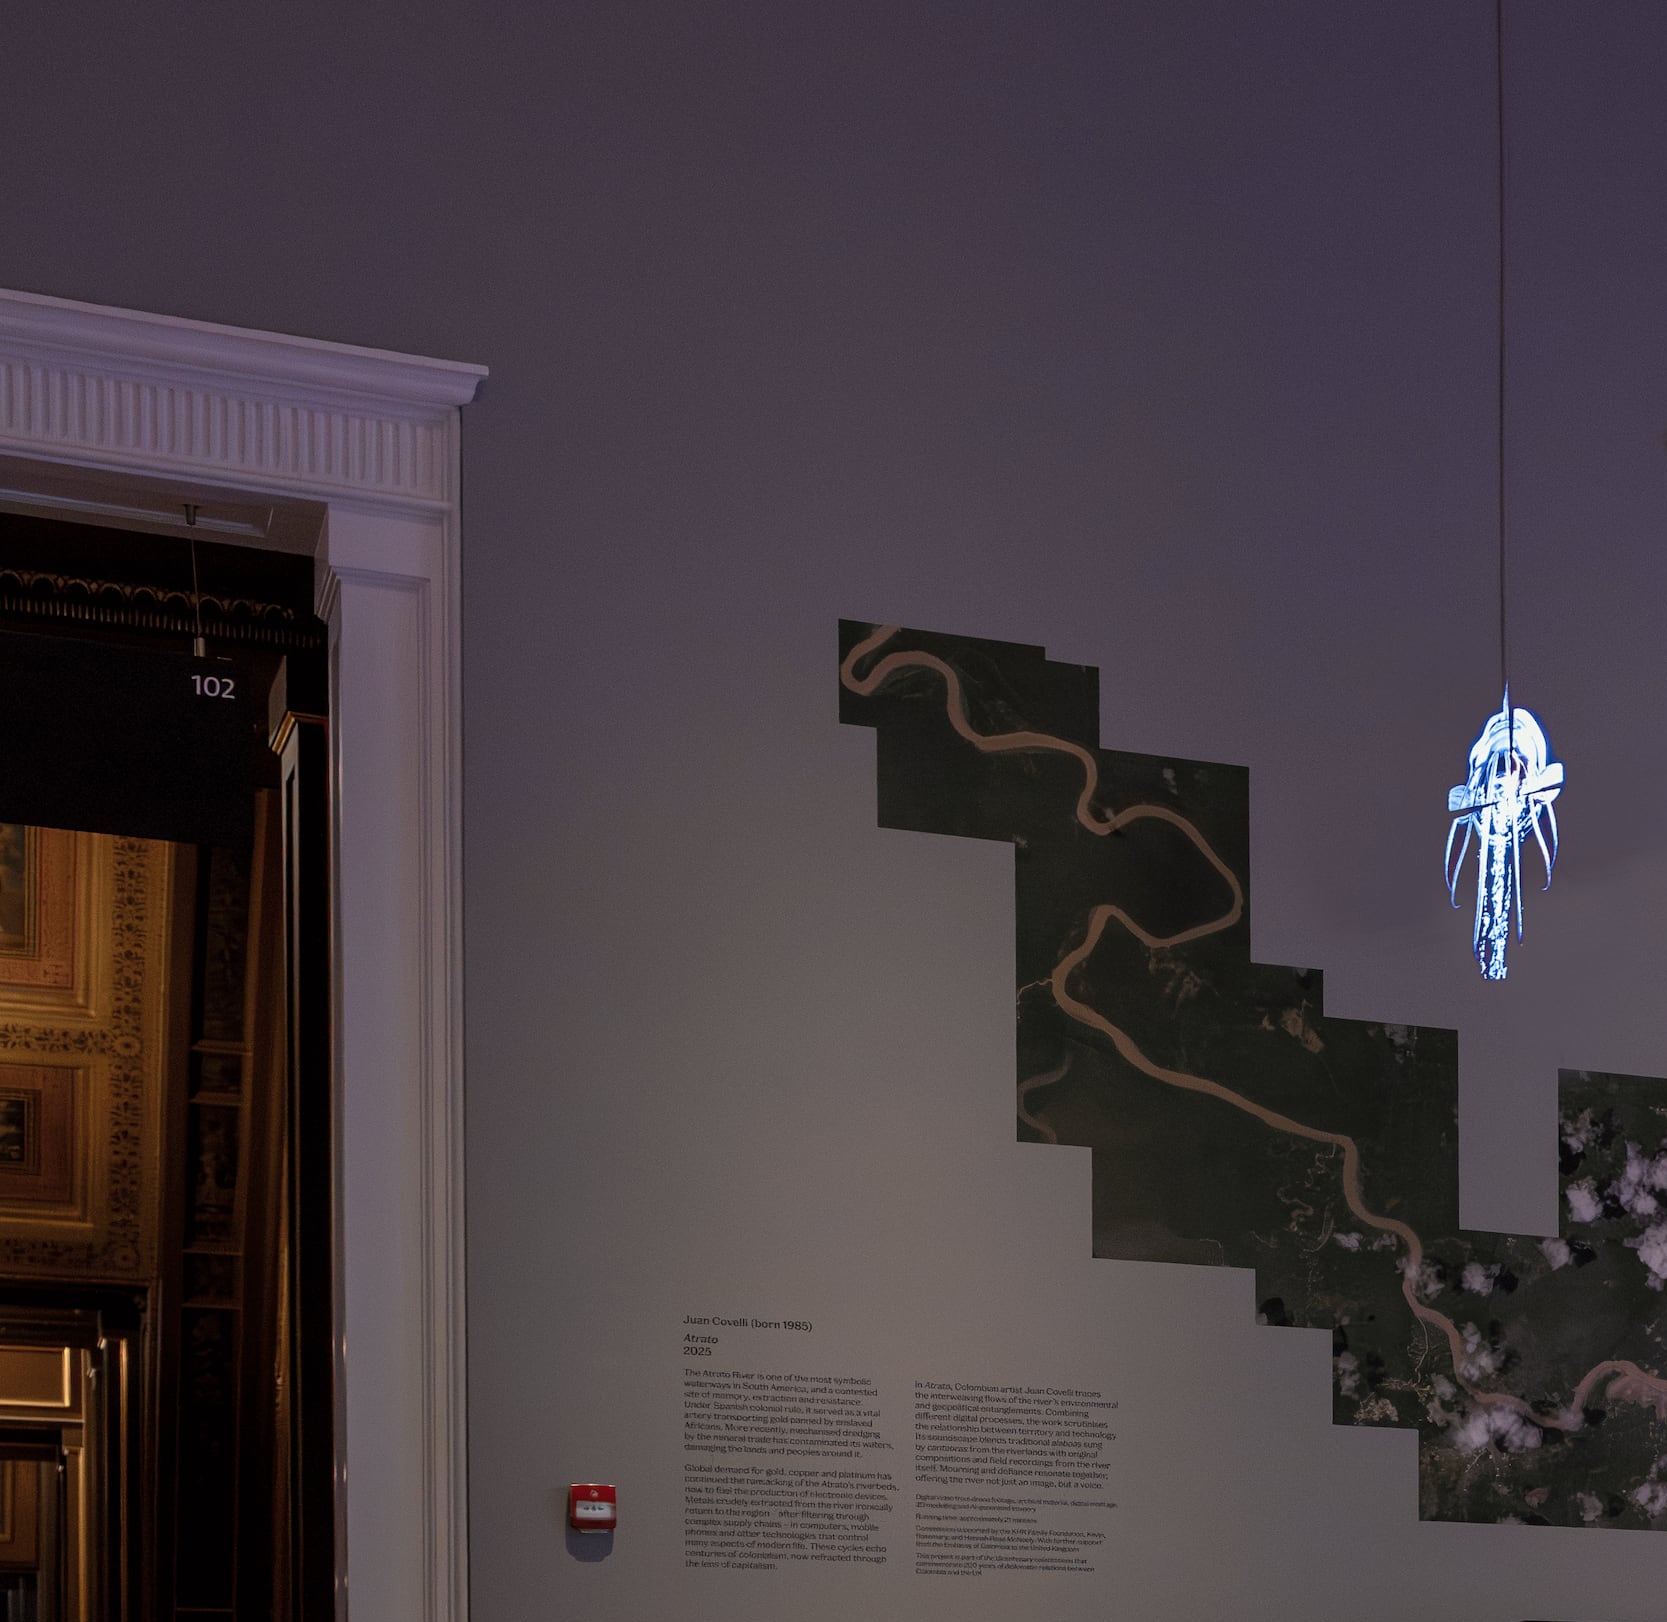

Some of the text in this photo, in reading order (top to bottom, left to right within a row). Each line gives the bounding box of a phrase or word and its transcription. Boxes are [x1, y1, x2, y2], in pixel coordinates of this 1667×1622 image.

[191, 675, 235, 699] 102
[682, 1314, 812, 1333] Juan Covelli (born 1985)
[683, 1332, 718, 1344] Atrato
[683, 1346, 711, 1356] 2025
[684, 1368, 700, 1376] The
[702, 1369, 730, 1378] Atrato
[732, 1371, 753, 1379] River
[794, 1374, 808, 1382] the
[809, 1375, 831, 1383] most
[833, 1376, 871, 1387] symbolic
[742, 1382, 768, 1390] South
[810, 1385, 826, 1393] and
[954, 1382, 998, 1392] Colombian
[1000, 1385, 1022, 1393] artist
[1024, 1386, 1044, 1394] Juan
[1046, 1387, 1073, 1396] Covelli
[1074, 1389, 1100, 1397] traces
[684, 1389, 814, 1403] site extraction and
[914, 1391, 1031, 1404] the flows the
[684, 1400, 710, 1408] Under
[713, 1401, 748, 1412] Spanish
[813, 1406, 842, 1415] served
[862, 1409, 880, 1417] vital
[914, 1401, 930, 1409] and
[1044, 1408, 1089, 1419] Combining
[684, 1411, 711, 1420] artery
[713, 1412, 768, 1423] transporting
[769, 1414, 788, 1424] gold
[789, 1415, 821, 1426] panned
[914, 1411, 951, 1420] different
[952, 1413, 977, 1423] digital
[1026, 1417, 1040, 1425] the
[1041, 1418, 1062, 1426] work
[724, 1423, 748, 1431] More
[789, 1426, 840, 1435] mechanised
[842, 1428, 880, 1439] dredging
[915, 1422, 1070, 1437] the relationship between territory and
[696, 1432, 710, 1440] the
[747, 1434, 770, 1443] trade
[772, 1435, 787, 1443] has
[789, 1436, 847, 1446] contaminated
[927, 1432, 1049, 1446] soundscape blends traditional
[684, 1442, 852, 1457] damaging the lands and peoples around
[969, 1445, 1097, 1460] from the riverlands with original
[915, 1453, 1110, 1468] compositions and field recordings from the river
[684, 1463, 891, 1480] Global demand for copper and platinum has
[939, 1464, 979, 1474] Mourning
[980, 1466, 996, 1474] and
[1034, 1469, 1070, 1477] resonate
[684, 1474, 819, 1487] continued the the
[915, 1473, 948, 1484] offering
[964, 1475, 984, 1483] river
[1057, 1479, 1071, 1487] but
[750, 1487, 797, 1498] production
[809, 1490, 853, 1499] electronic
[685, 1495, 893, 1512] Metals crudely extracted from the river ironically
[725, 1507, 869, 1522] the region after filtering through
[684, 1517, 879, 1531] complex supply chains mobile
[719, 1528, 734, 1536] and
[736, 1529, 760, 1537] other
[762, 1530, 816, 1541] technologies
[818, 1532, 836, 1540] that
[837, 1532, 868, 1541] control
[685, 1540, 708, 1548] many
[757, 1540, 790, 1549] modern
[810, 1542, 836, 1550] These
[837, 1543, 864, 1553] cycles
[865, 1544, 886, 1552] echo
[685, 1548, 886, 1564] centuries refracted through
[685, 1559, 699, 1567] the
[701, 1560, 719, 1568] lens
